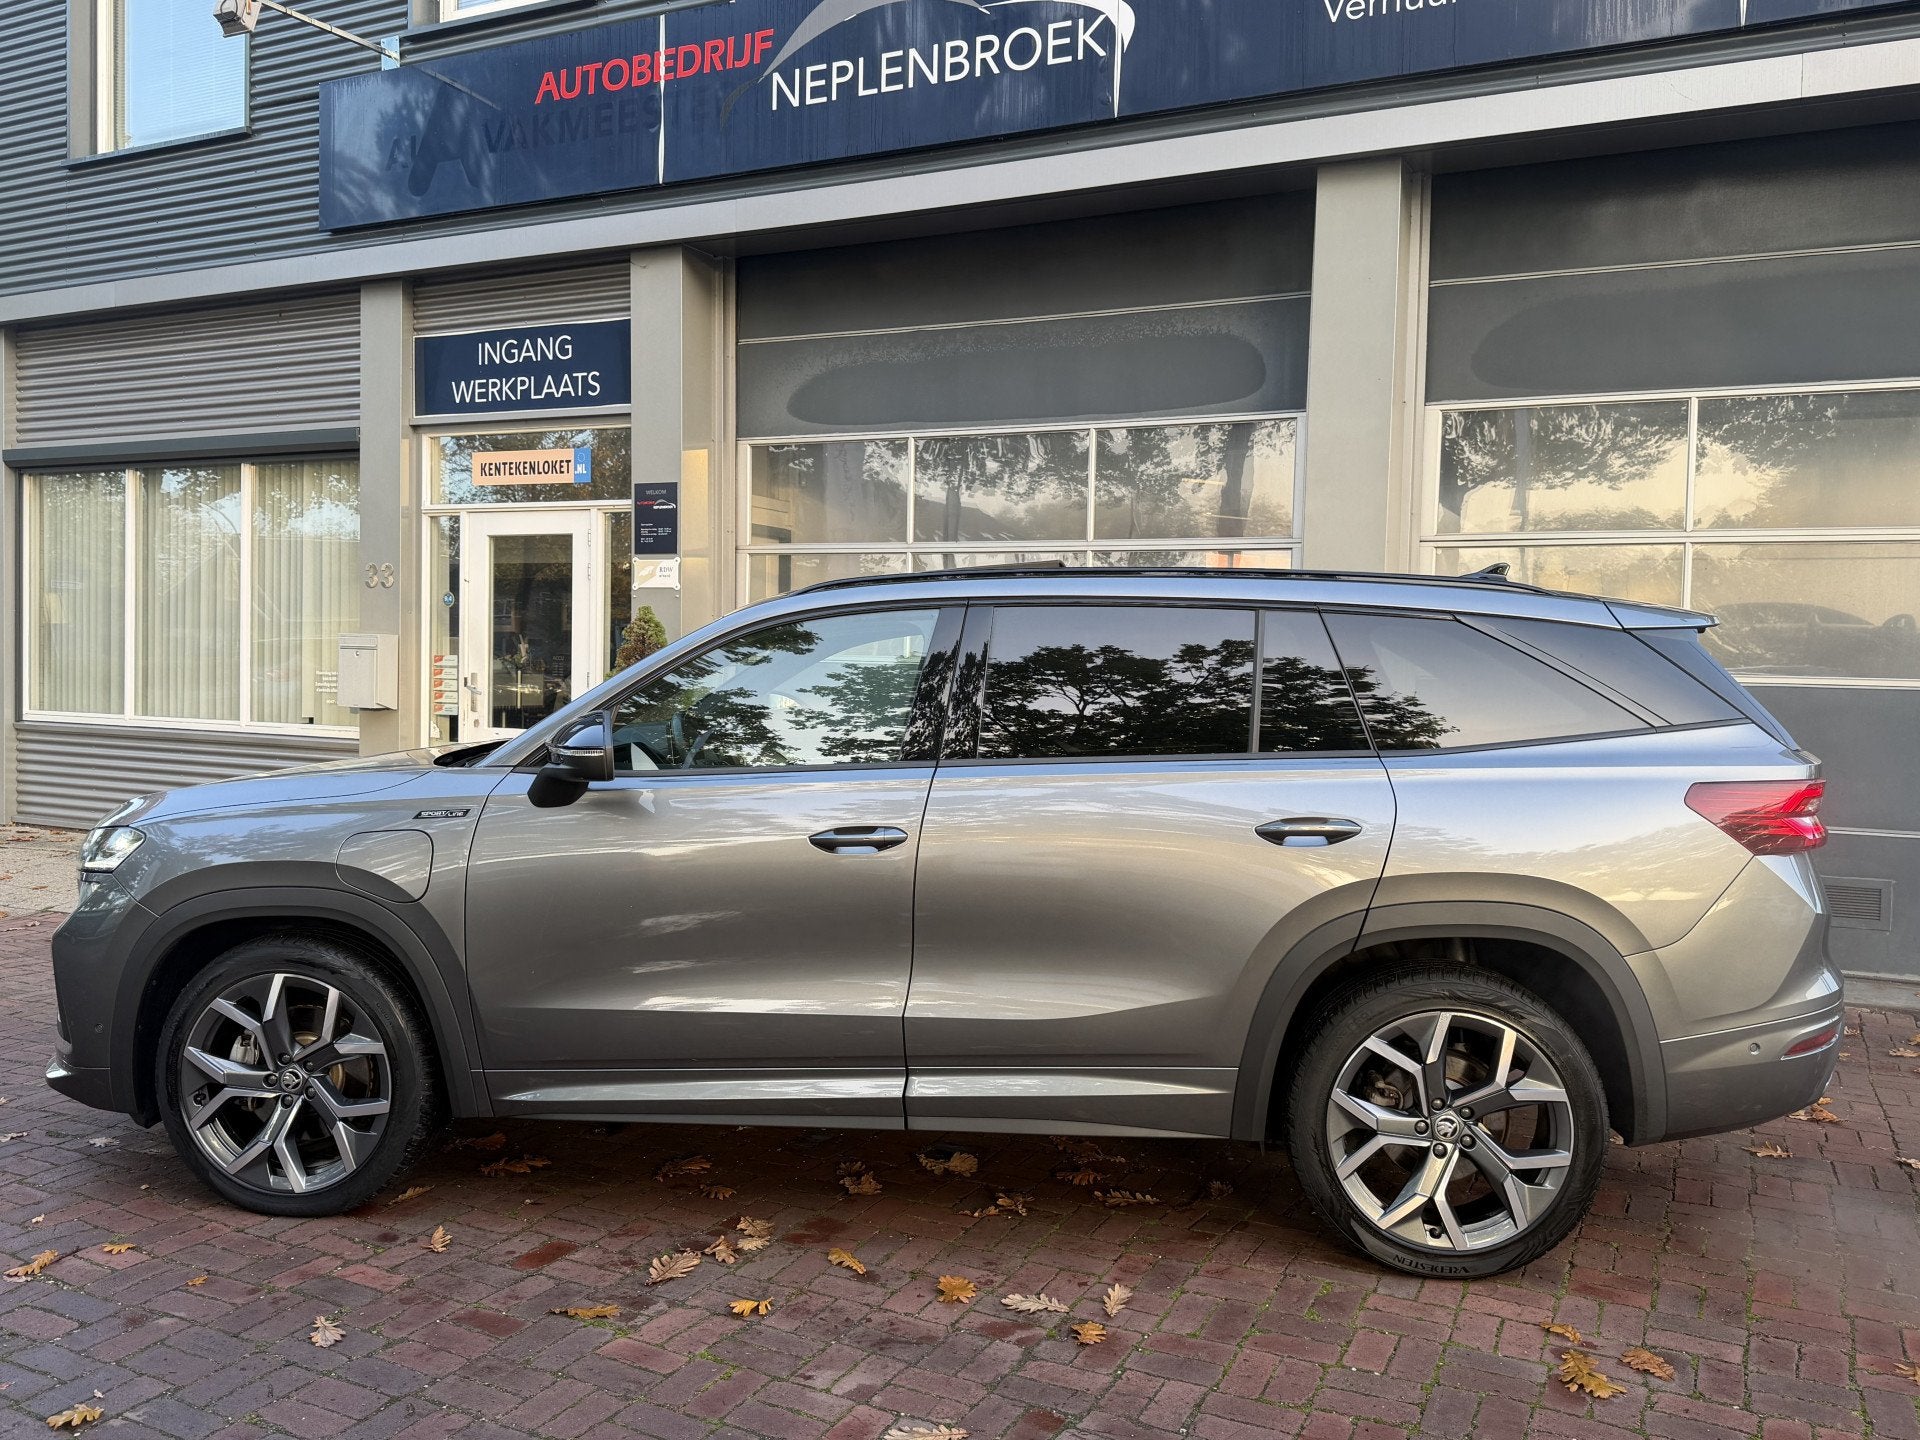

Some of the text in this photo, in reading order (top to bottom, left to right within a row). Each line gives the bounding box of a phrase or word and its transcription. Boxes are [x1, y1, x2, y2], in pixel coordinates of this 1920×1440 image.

[535, 29, 774, 104] AUTOBEDRIJF
[772, 14, 1107, 111] NEPLENBROEK
[478, 335, 573, 366] INGANG
[451, 371, 601, 404] WERKPLAATS
[364, 562, 395, 589] 33
[1393, 1253, 1470, 1274] VREDESTEIN
